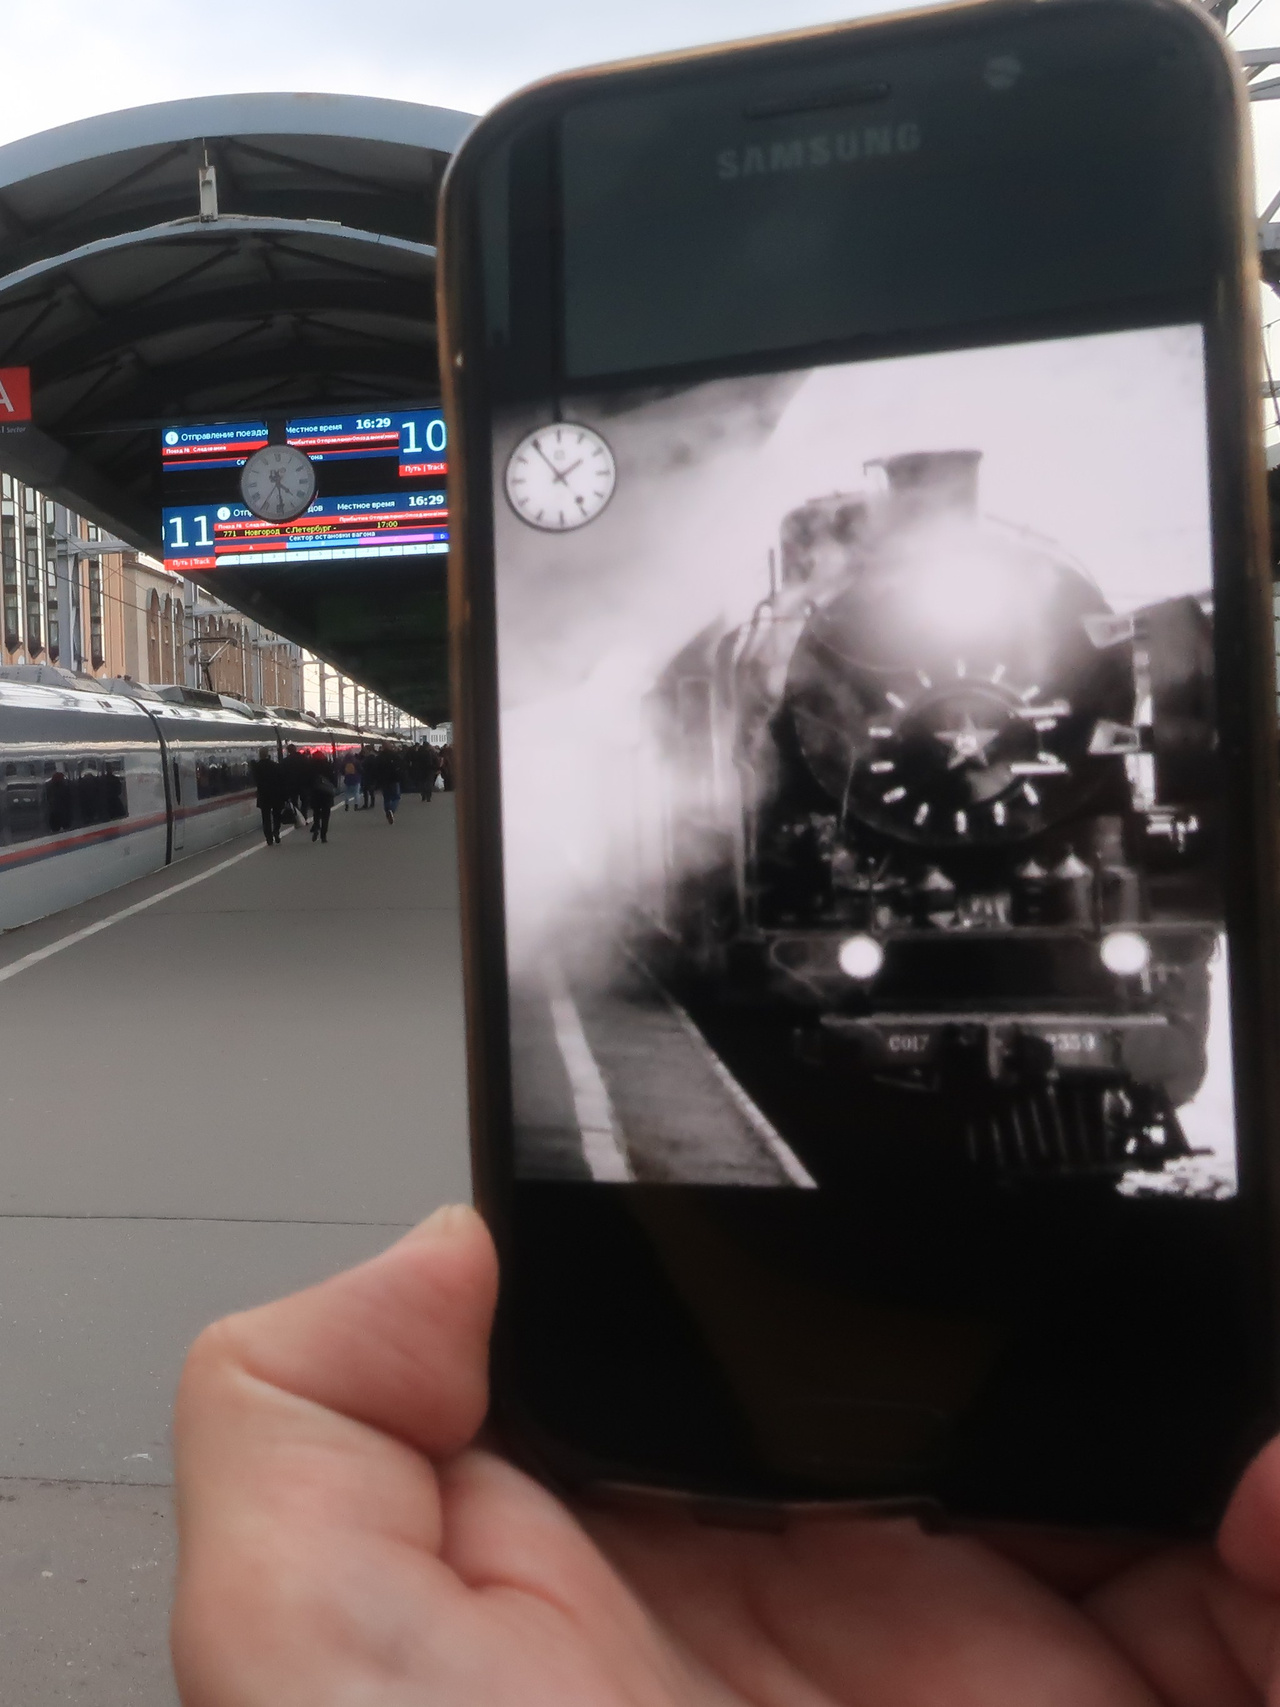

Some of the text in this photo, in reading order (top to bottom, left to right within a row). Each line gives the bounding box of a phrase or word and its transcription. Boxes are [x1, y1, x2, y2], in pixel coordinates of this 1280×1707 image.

[716, 123, 921, 181] SAMSUNG
[319, 423, 342, 433] время
[355, 417, 391, 430] 16:29
[6, 426, 26, 434] Sector
[181, 430, 234, 443] Отправление
[401, 419, 447, 454] 10
[405, 463, 445, 473] Путь Track
[337, 501, 395, 511] Местное время
[408, 494, 445, 507] 16:29
[376, 520, 398, 529] 17:00
[169, 515, 214, 548] 11
[223, 530, 237, 538] 771
[244, 528, 280, 537] Новгород
[289, 530, 376, 542] Сектор остановки вагона
[193, 558, 211, 566] Track
